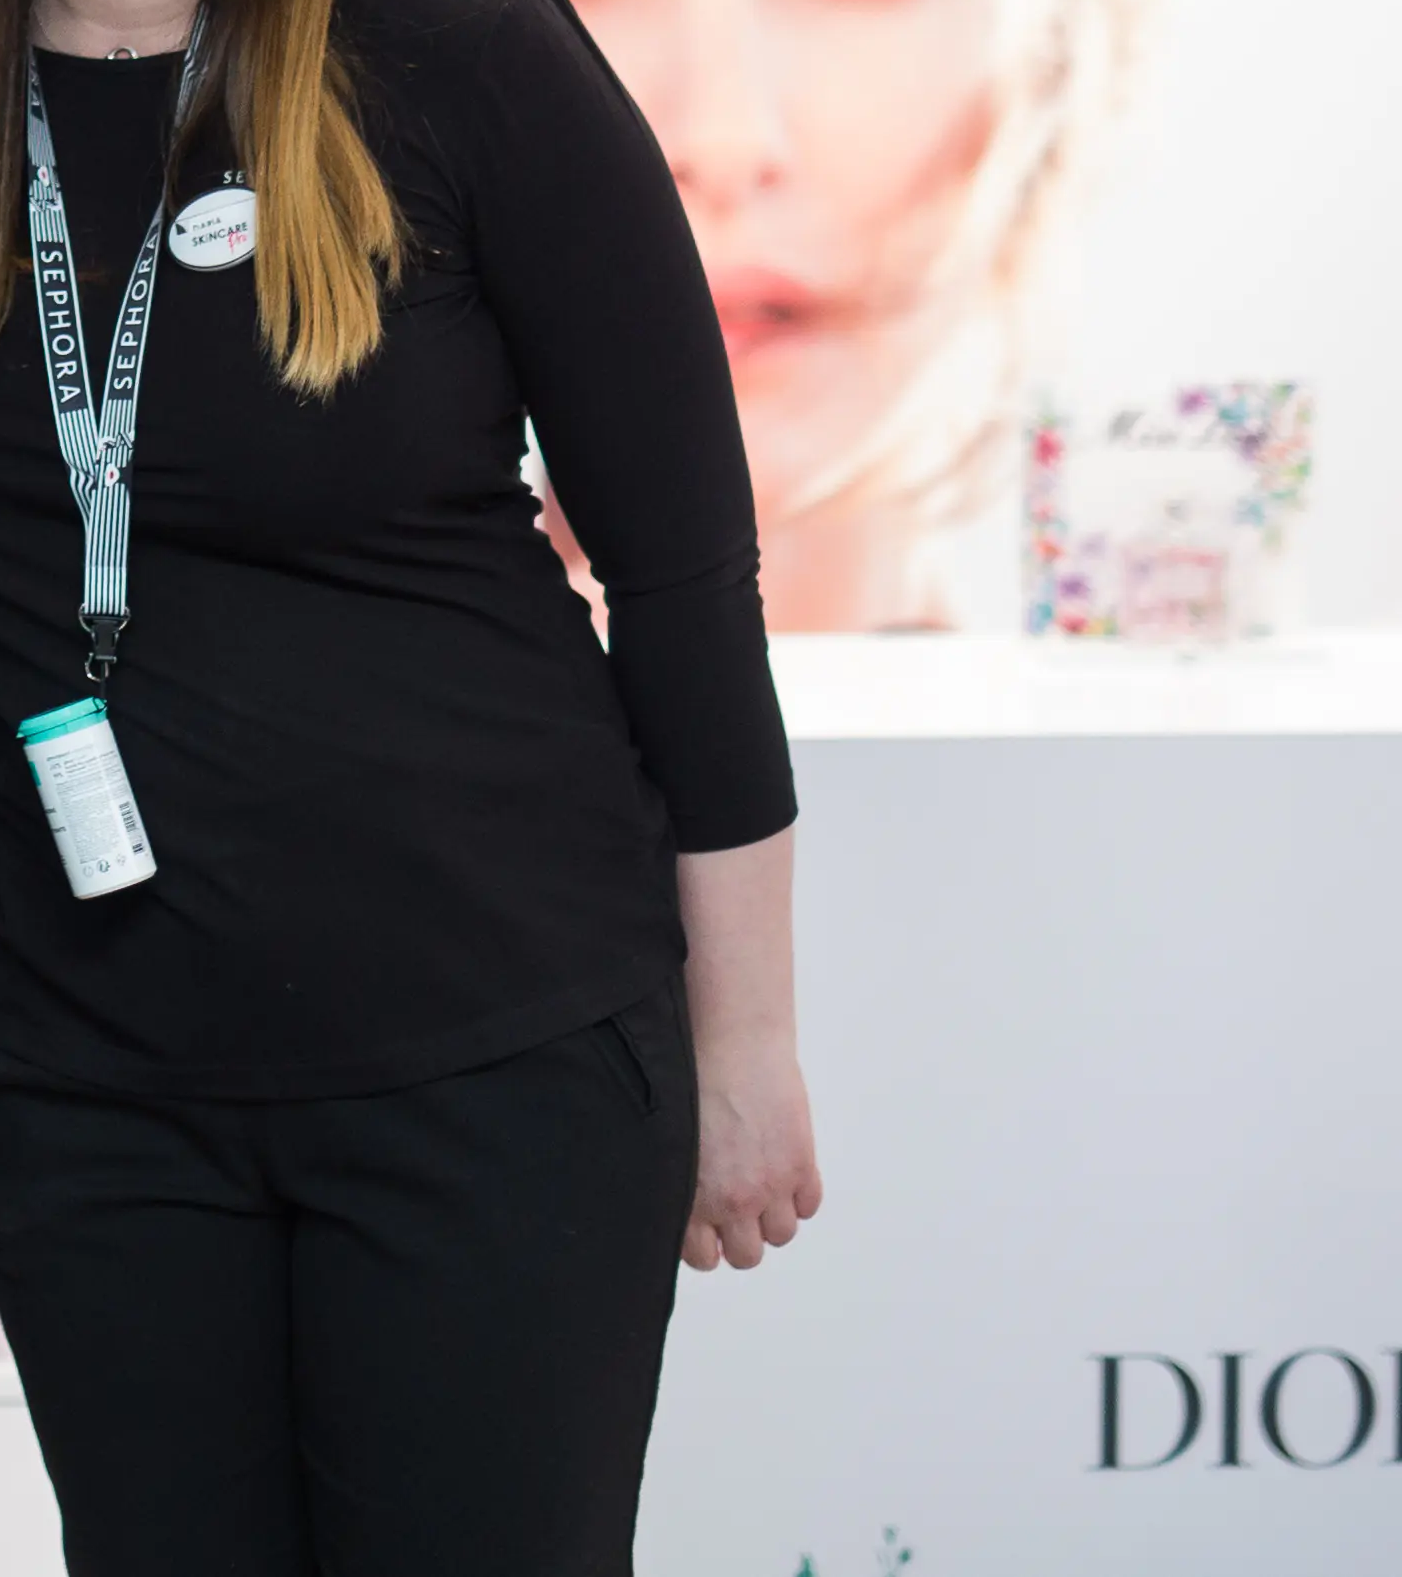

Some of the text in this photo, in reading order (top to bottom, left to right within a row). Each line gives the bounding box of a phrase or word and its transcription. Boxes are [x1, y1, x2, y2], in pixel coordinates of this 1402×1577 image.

[191, 222, 248, 247] SKINCARE
[40, 249, 81, 404] SEPHORA
[113, 226, 159, 390] SEPHORA
[1084, 1346, 1402, 1472] DIO
